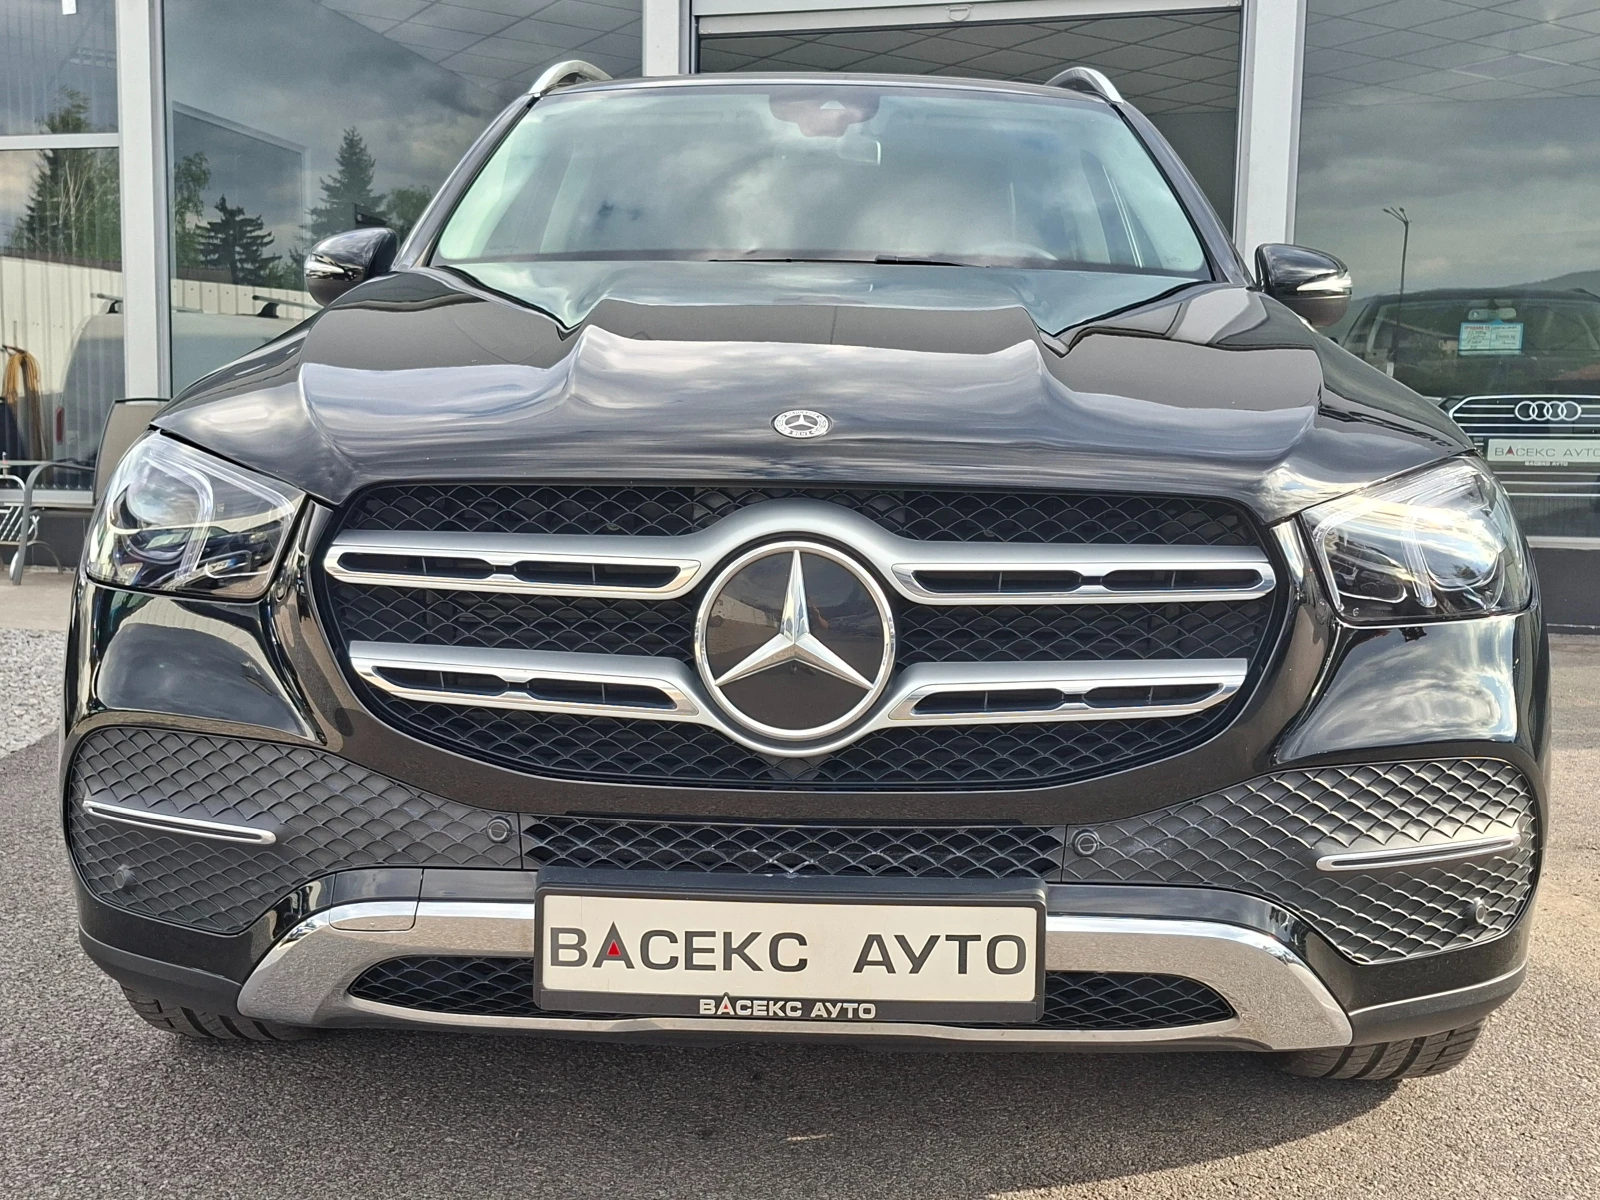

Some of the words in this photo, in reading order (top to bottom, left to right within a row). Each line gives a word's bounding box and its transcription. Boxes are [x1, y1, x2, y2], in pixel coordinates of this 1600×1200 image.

[1494, 445, 1556, 458] ВАСЕКС
[549, 921, 809, 973] ВАСЕКС
[852, 933, 1028, 976] АУТО
[699, 995, 802, 1018] ВАСЕКС
[810, 1002, 877, 1019] АУТО
